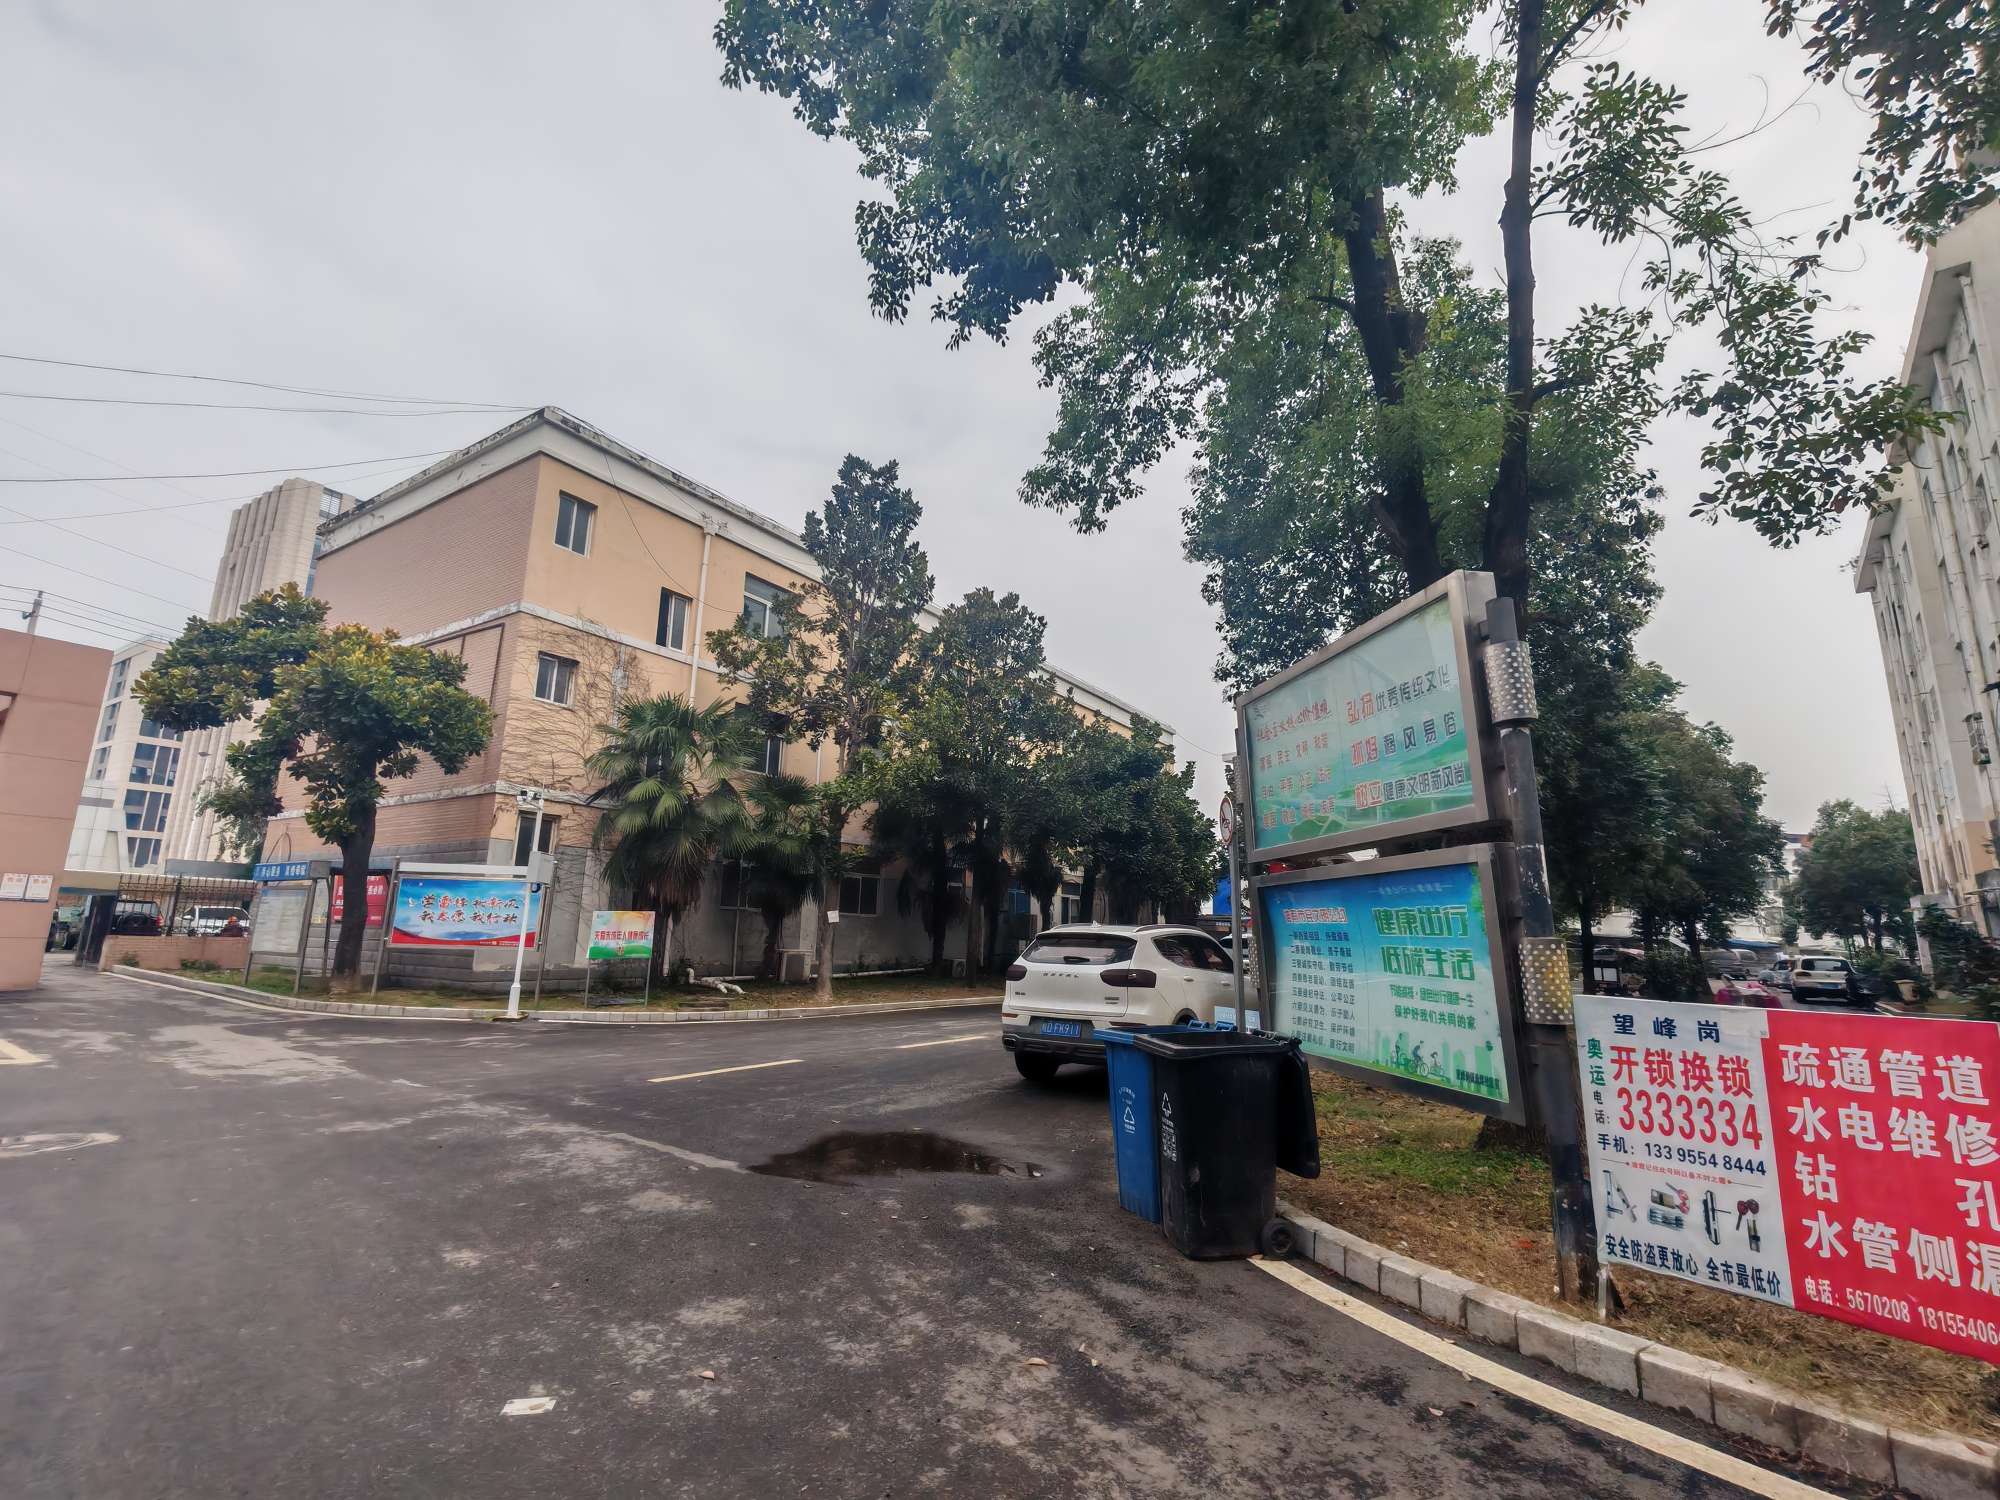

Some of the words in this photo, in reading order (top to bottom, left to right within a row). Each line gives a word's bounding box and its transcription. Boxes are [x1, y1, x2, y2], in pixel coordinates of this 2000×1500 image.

[1373, 905, 1469, 938] 健康出行
[1380, 945, 1476, 981] 低碳生活
[1612, 1013, 1721, 1043] 望峰岗
[1587, 1038, 1606, 1086] 奥运
[1609, 1045, 1754, 1098] 开锁换锁
[1779, 1042, 1990, 1106] 疏通管道
[1617, 1087, 1763, 1150] 3333334
[1787, 1096, 2000, 1167] 水电维修
[1645, 1142, 1673, 1160] 133
[1677, 1149, 1718, 1168] 9554
[1723, 1155, 1767, 1176] 8444
[1794, 1151, 1839, 1202] 钻
[1955, 1178, 2000, 1232] 孔
[1605, 1233, 1699, 1276] 安全防盗更放心
[1706, 1257, 1781, 1297] 全市最低价
[1802, 1210, 2000, 1297] 水管侧漏
[1846, 1287, 1911, 1323] 5670208
[1918, 1305, 2000, 1346] 18155406
